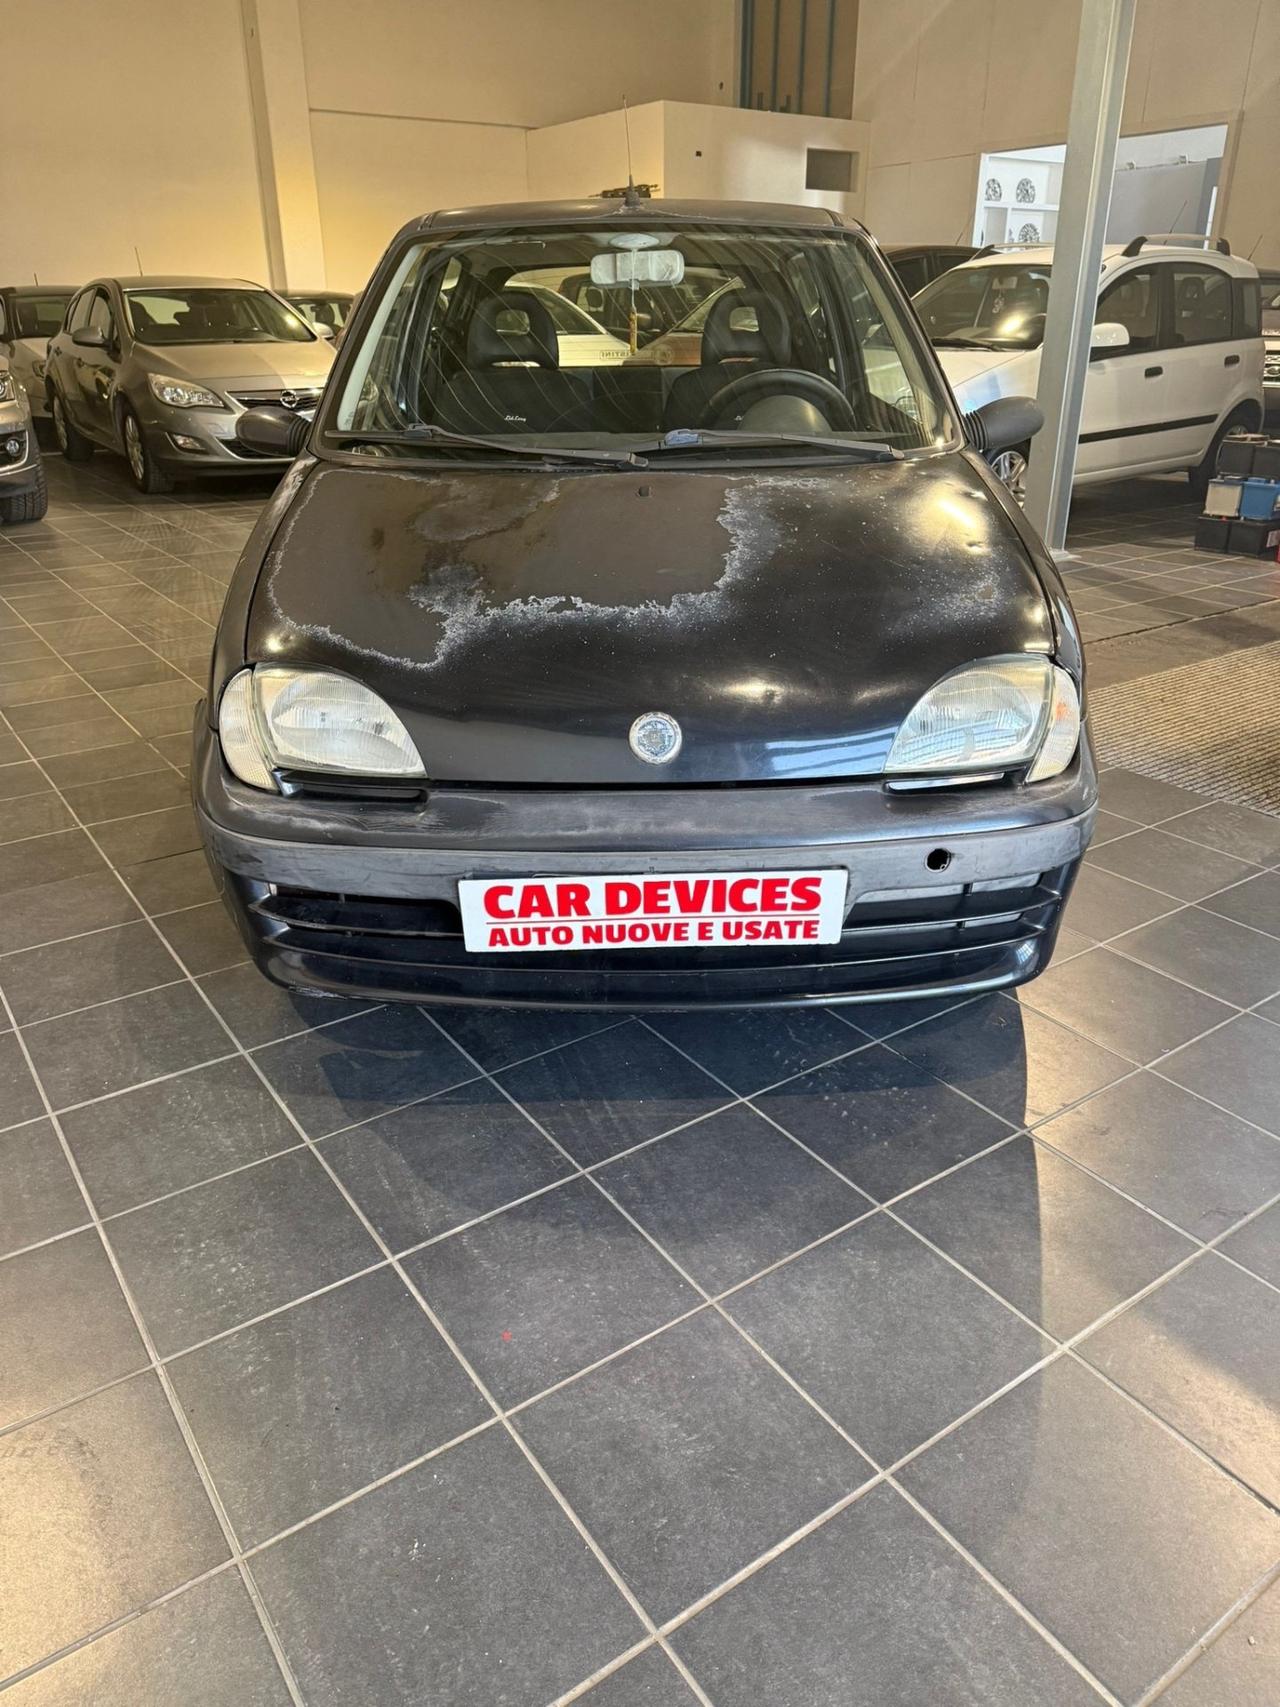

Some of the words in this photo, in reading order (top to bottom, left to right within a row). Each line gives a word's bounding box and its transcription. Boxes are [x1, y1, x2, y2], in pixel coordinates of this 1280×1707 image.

[483, 882, 591, 919] CAR
[604, 876, 822, 917] DEVICES
[488, 924, 575, 948] AUTO
[581, 921, 689, 945] NUOVE
[697, 921, 713, 941] E
[721, 919, 820, 941] USATE
